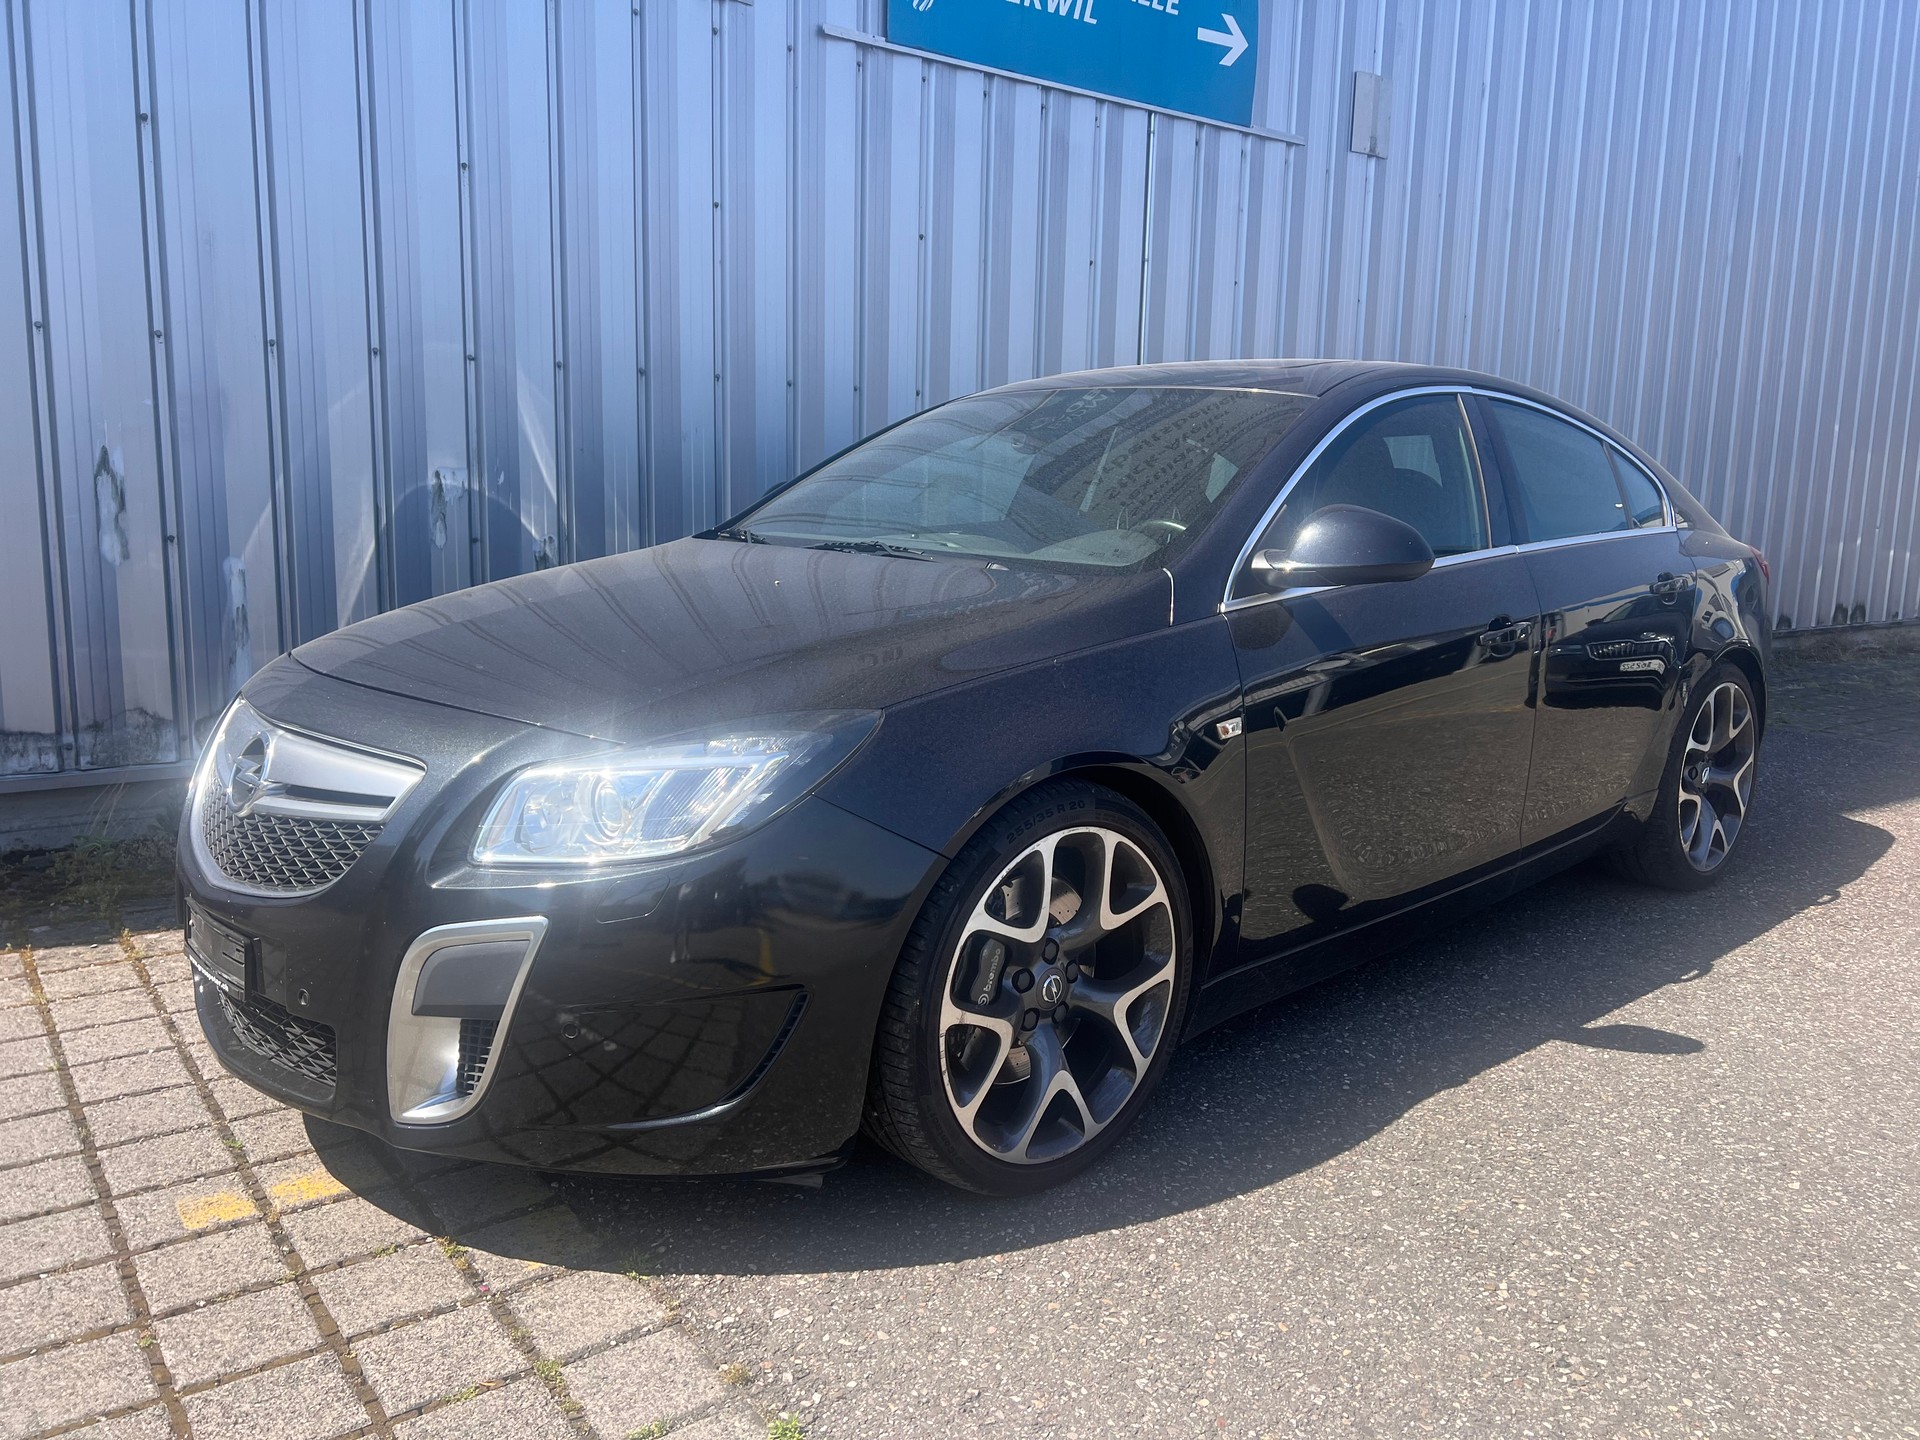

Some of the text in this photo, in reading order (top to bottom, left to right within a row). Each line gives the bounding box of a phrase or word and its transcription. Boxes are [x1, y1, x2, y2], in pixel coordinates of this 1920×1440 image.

[1006, 0, 1098, 25] WIL
[1006, 800, 1086, 845] 255/35 R 20
[983, 948, 1001, 992] brembo
